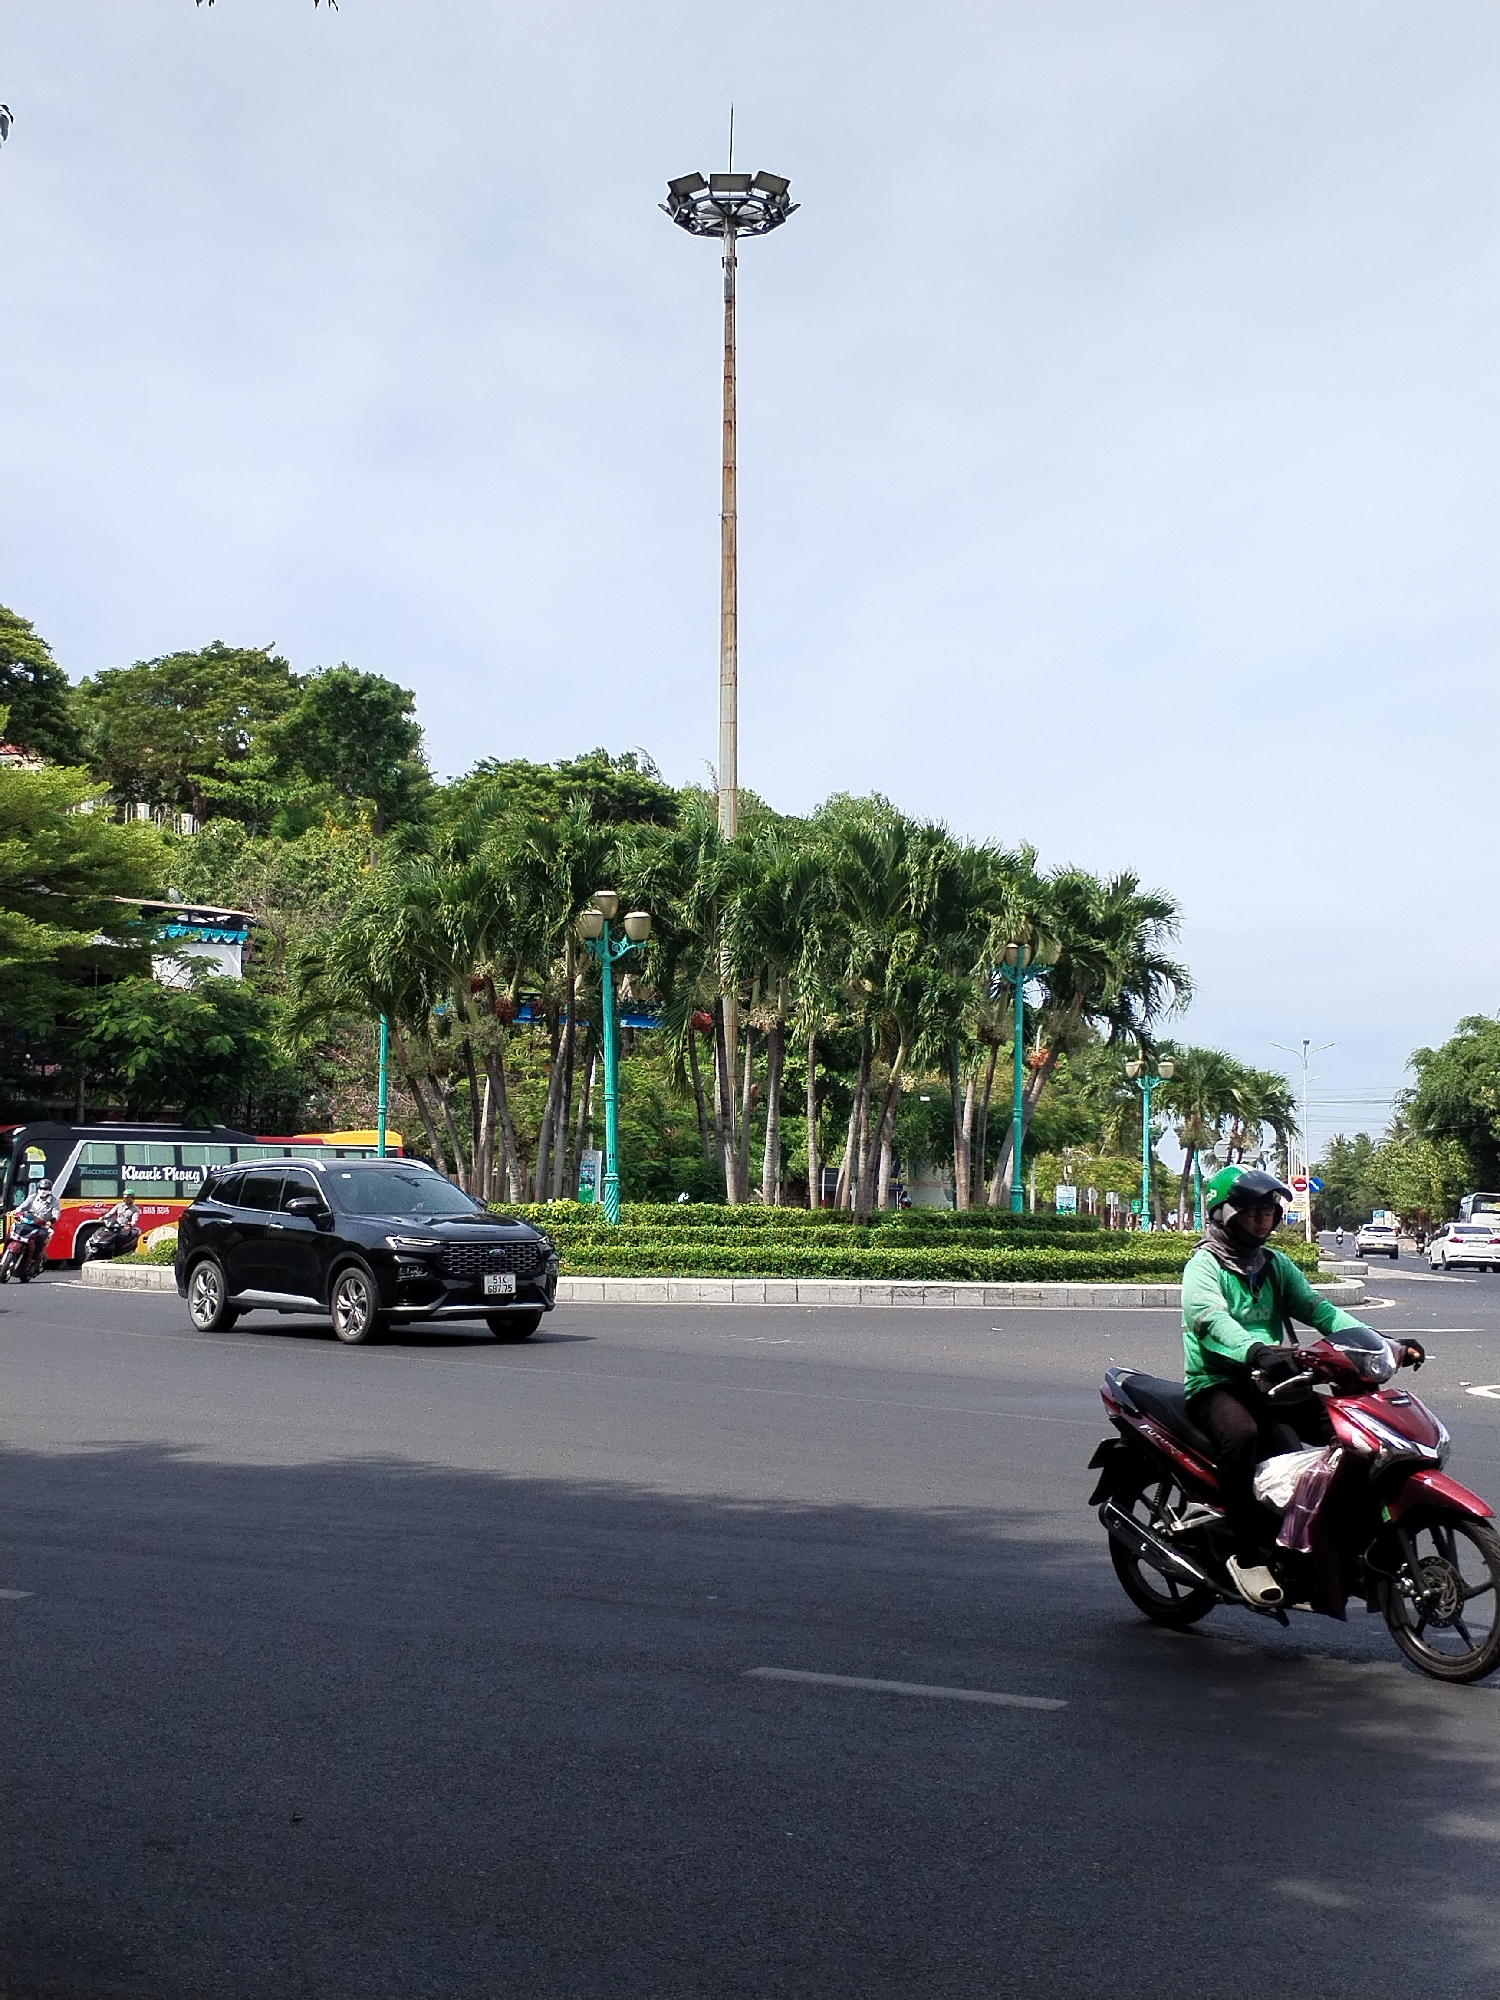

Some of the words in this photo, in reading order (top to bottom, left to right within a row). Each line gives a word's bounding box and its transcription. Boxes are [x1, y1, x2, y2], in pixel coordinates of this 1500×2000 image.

[121, 1165, 162, 1181] Khanh
[162, 1166, 201, 1184] Phong
[493, 1275, 507, 1285] 51K
